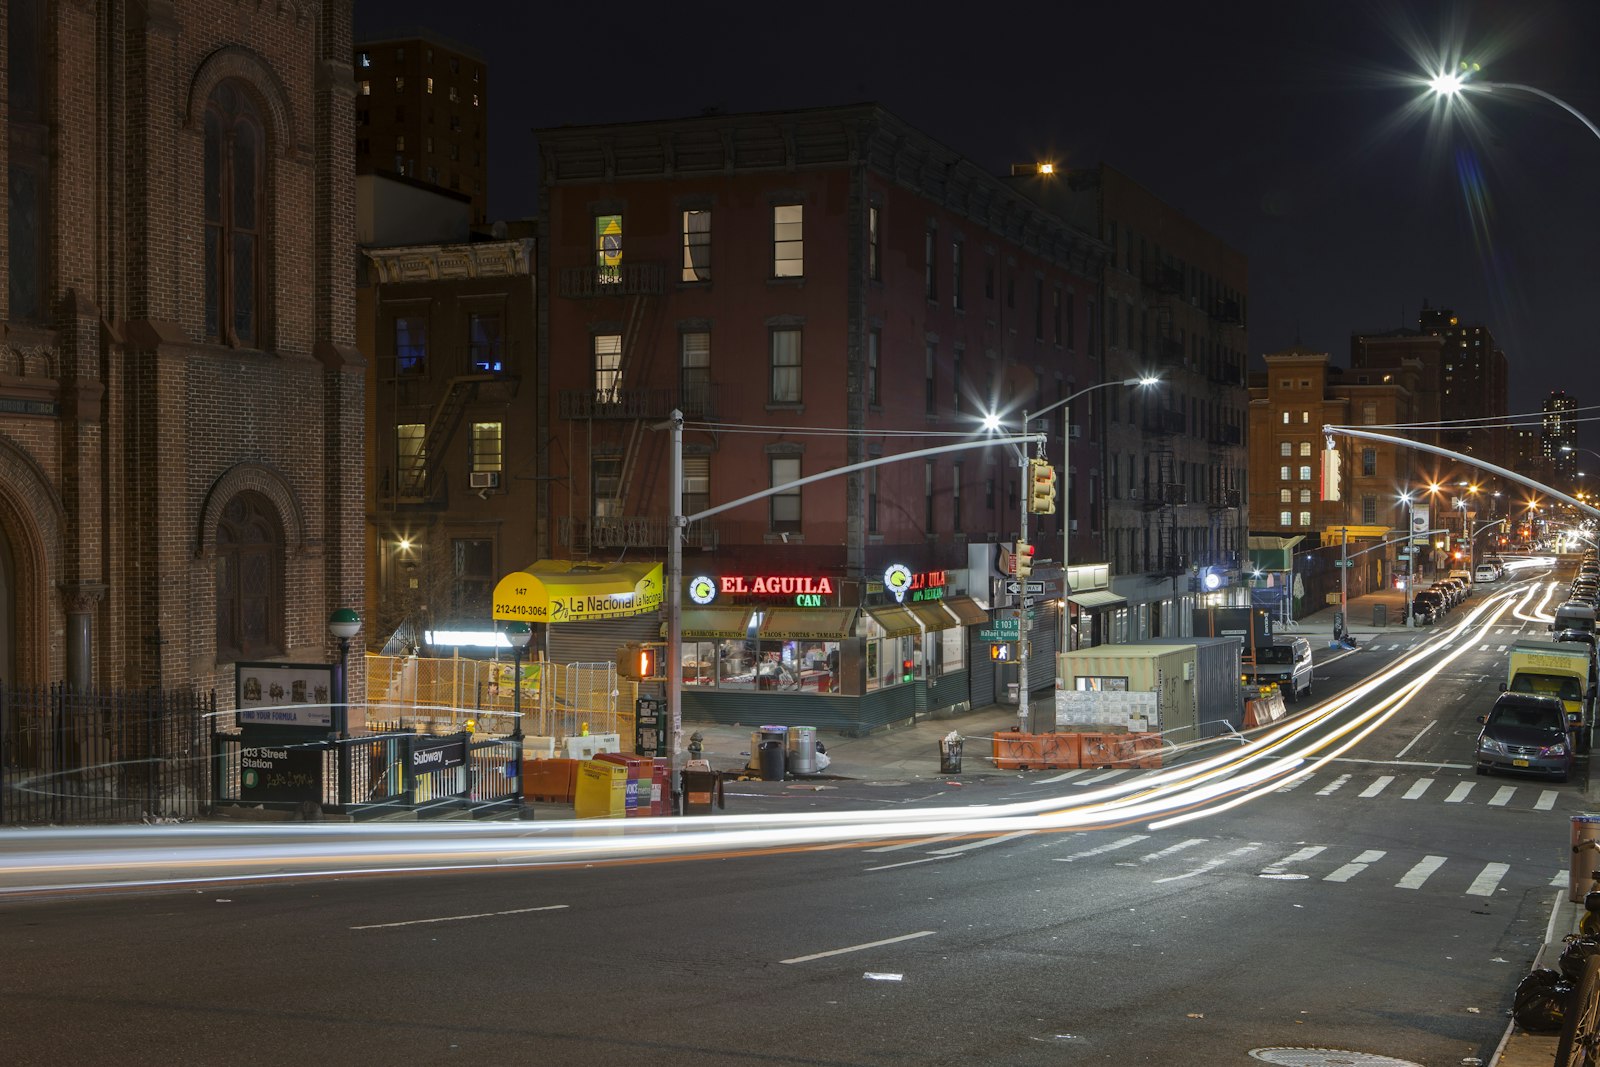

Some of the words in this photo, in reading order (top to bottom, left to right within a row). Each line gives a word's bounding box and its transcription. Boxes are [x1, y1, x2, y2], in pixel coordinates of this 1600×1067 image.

[515, 587, 527, 595] 147
[721, 577, 748, 593] EL
[752, 577, 832, 594] AGUILA
[570, 597, 584, 612] La
[587, 594, 634, 612] Nacional
[636, 595, 642, 606] La
[496, 604, 547, 616] 212-410-3064
[995, 621, 999, 629] E
[1001, 620, 1012, 629] 103
[980, 629, 999, 637] Rafael
[243, 711, 255, 719] FIND
[257, 711, 271, 720] YOUR
[272, 711, 297, 720] FORMULA
[243, 747, 258, 757] 103
[261, 747, 288, 759] Street
[413, 750, 443, 766] Subway
[242, 757, 273, 769] Station
[626, 783, 639, 794] VOICE
